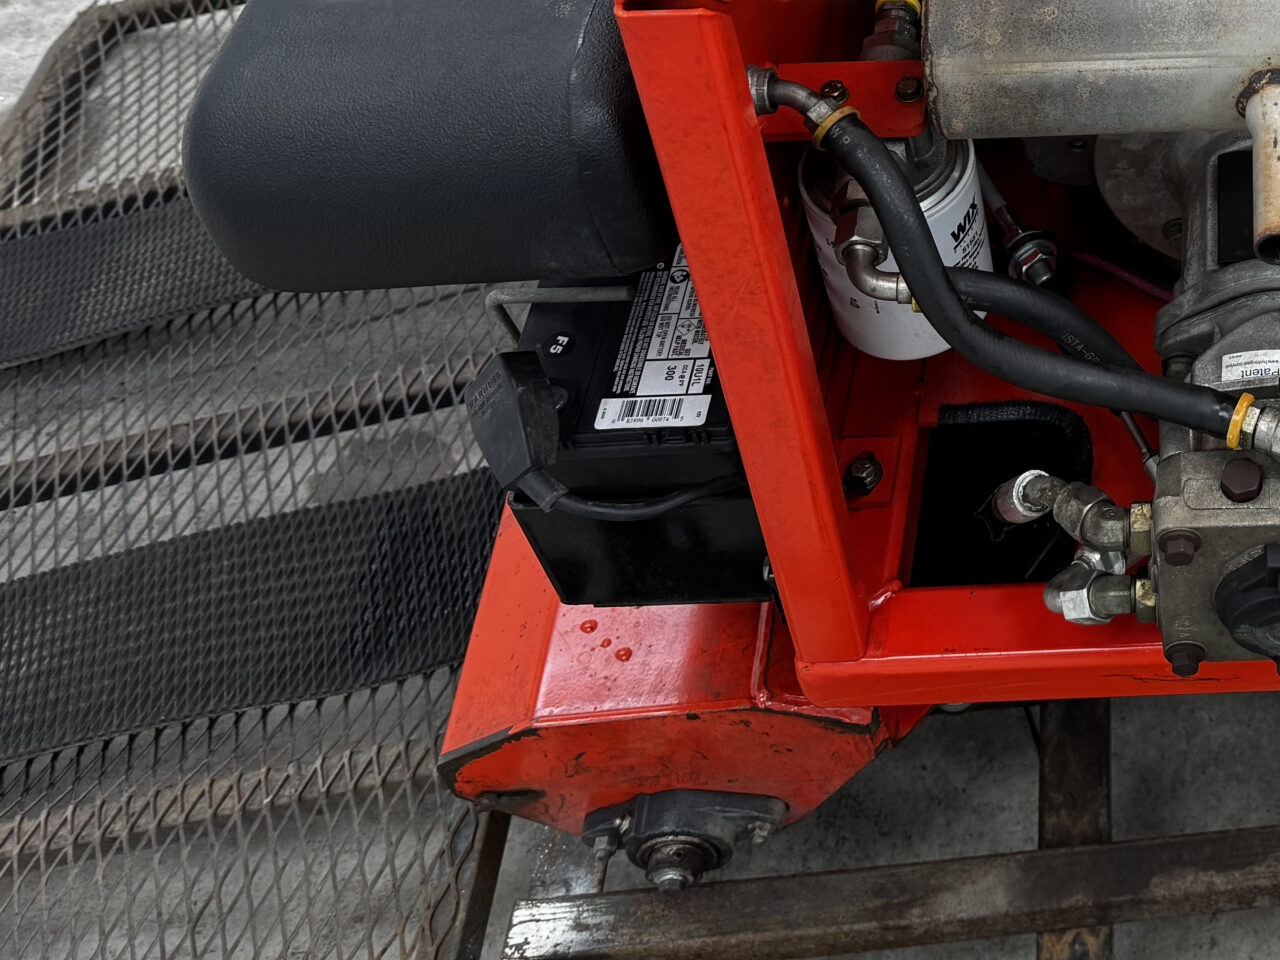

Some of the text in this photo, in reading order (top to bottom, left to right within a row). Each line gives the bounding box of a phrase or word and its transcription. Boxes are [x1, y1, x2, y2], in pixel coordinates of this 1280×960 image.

[950, 193, 978, 243] WIX
[550, 336, 570, 354] F5
[663, 365, 677, 380] 300
[690, 363, 705, 386] 10U1L
[1240, 368, 1280, 378] Patent
